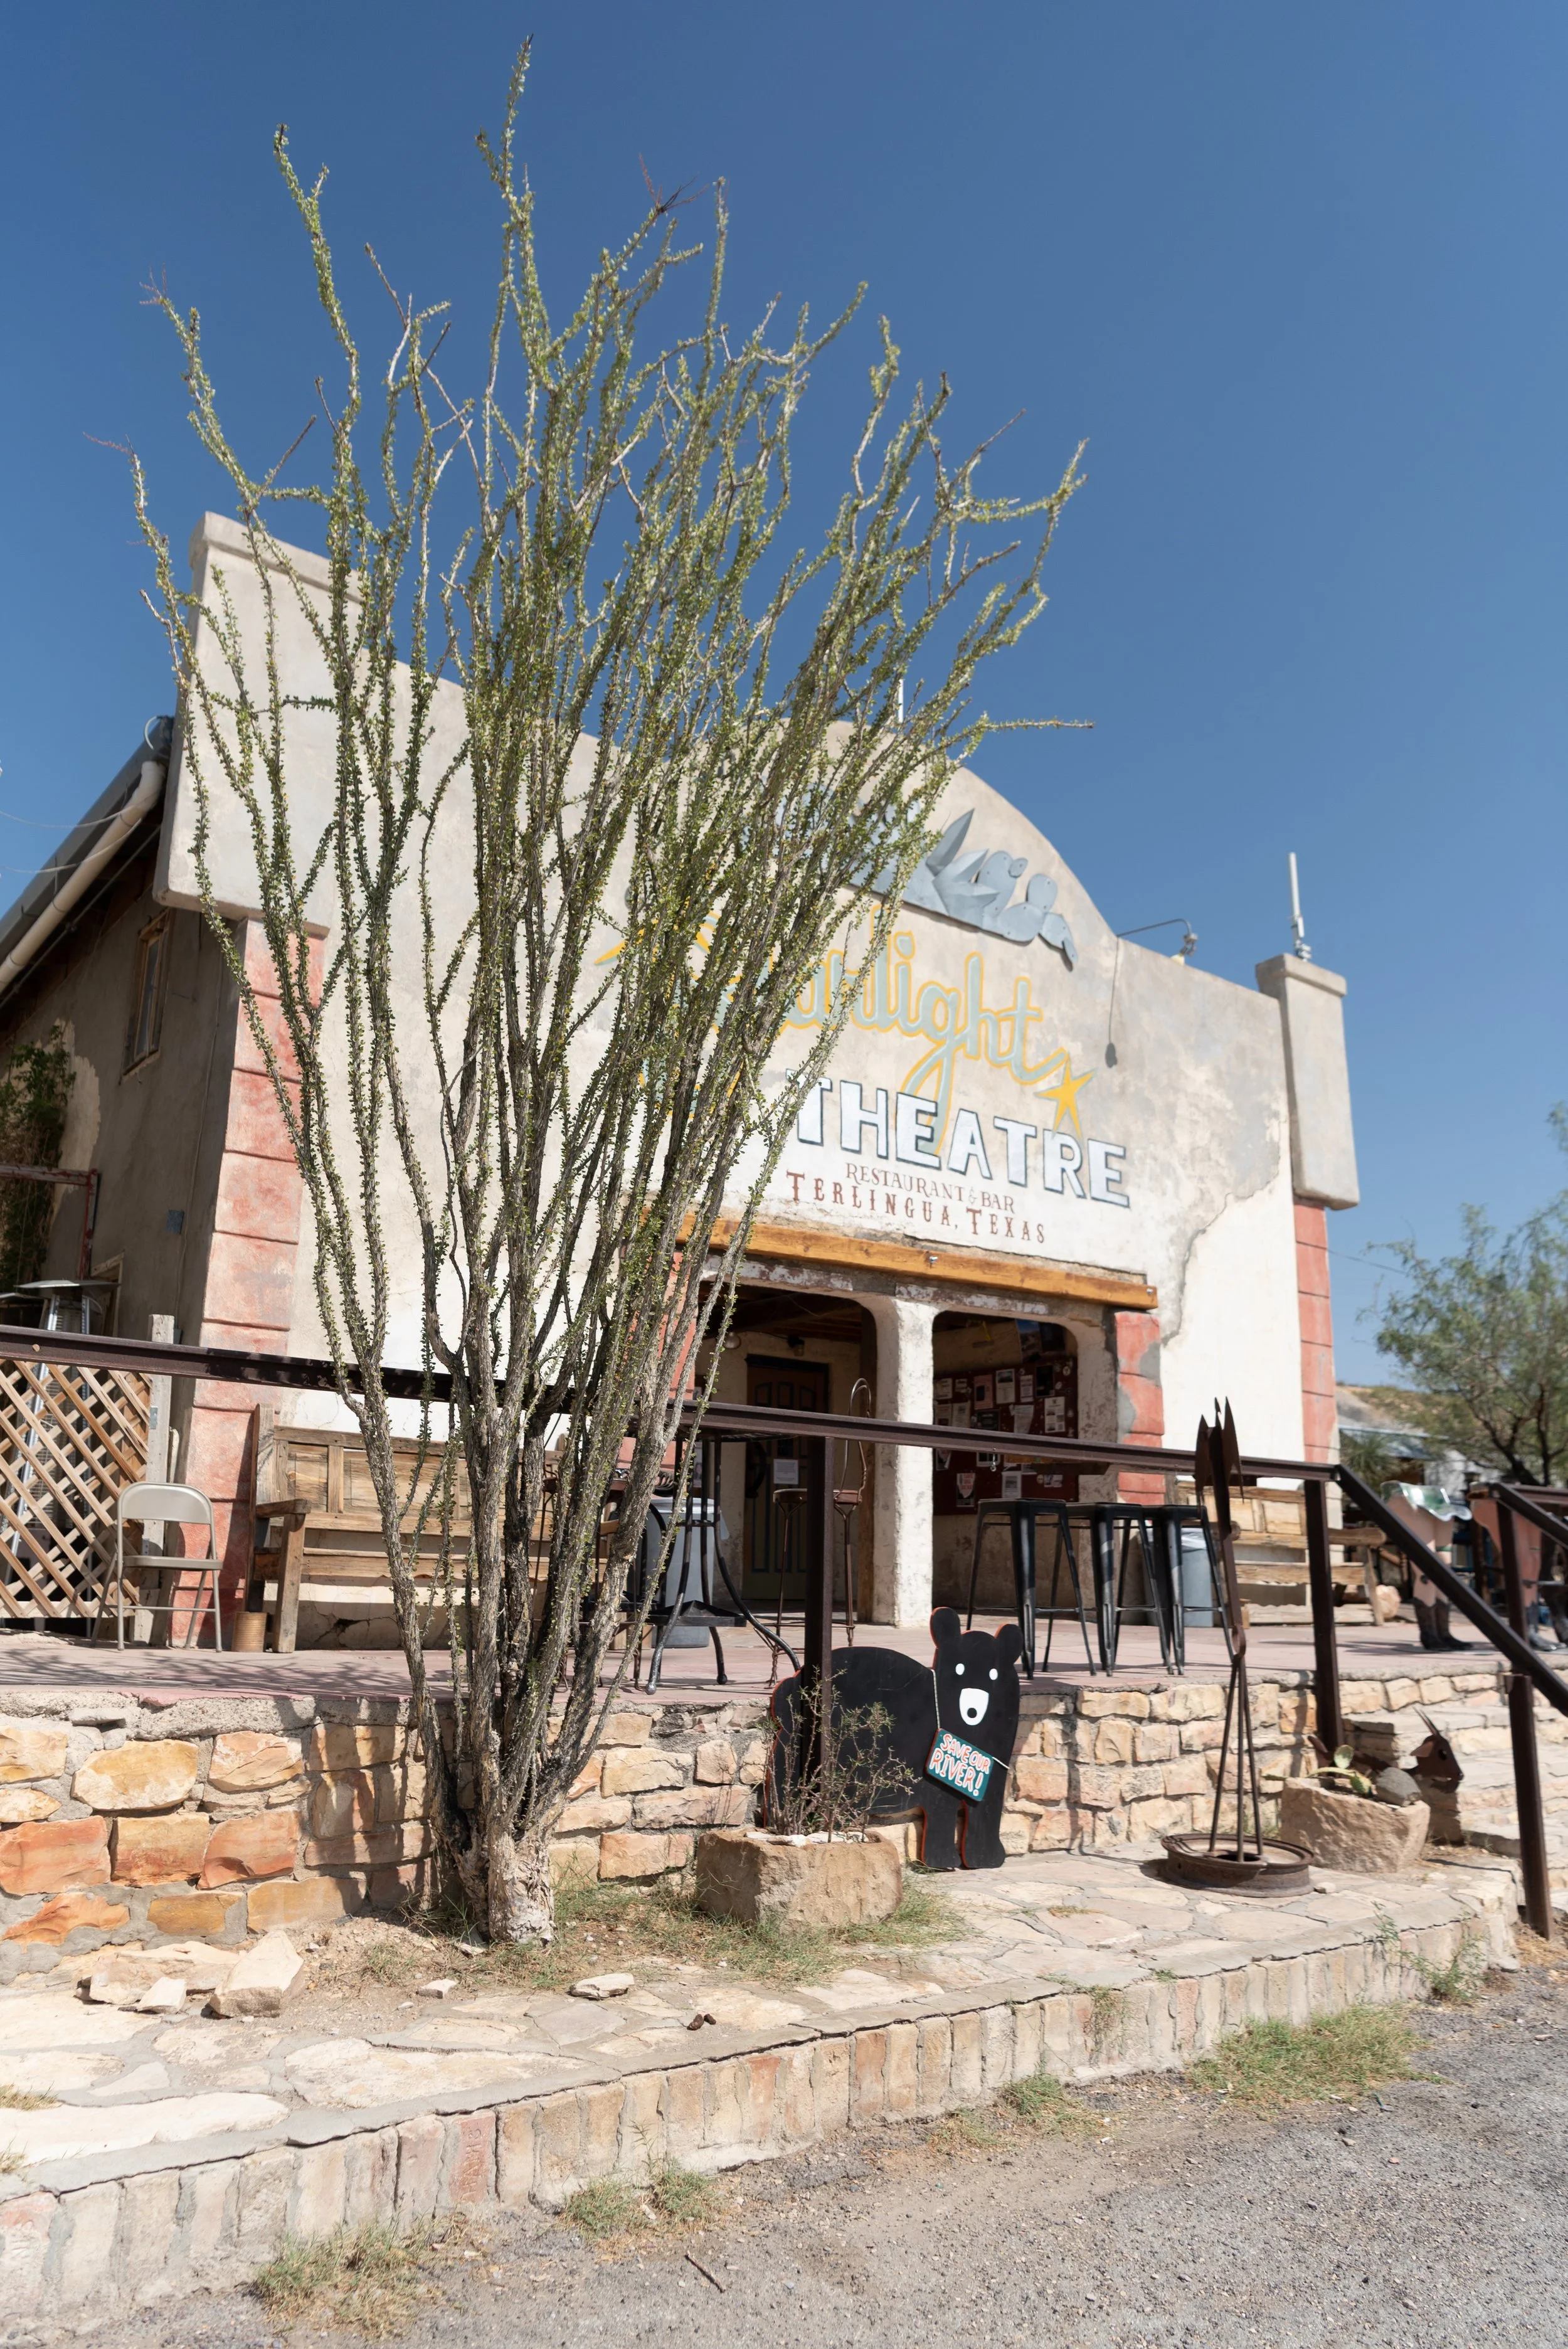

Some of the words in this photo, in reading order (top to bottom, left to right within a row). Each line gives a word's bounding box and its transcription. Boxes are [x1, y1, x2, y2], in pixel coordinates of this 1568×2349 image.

[786, 1068, 1131, 1209] THEATRE
[786, 1169, 958, 1230] TERLINGUA,
[966, 1207, 1046, 1244] TEXAS
[845, 1162, 965, 1203] RESTAURANT
[981, 1191, 1015, 1214] BAR
[929, 1747, 984, 1796] RIVER!
[940, 1734, 972, 1764] SAVE
[969, 1751, 991, 1774] OUR
